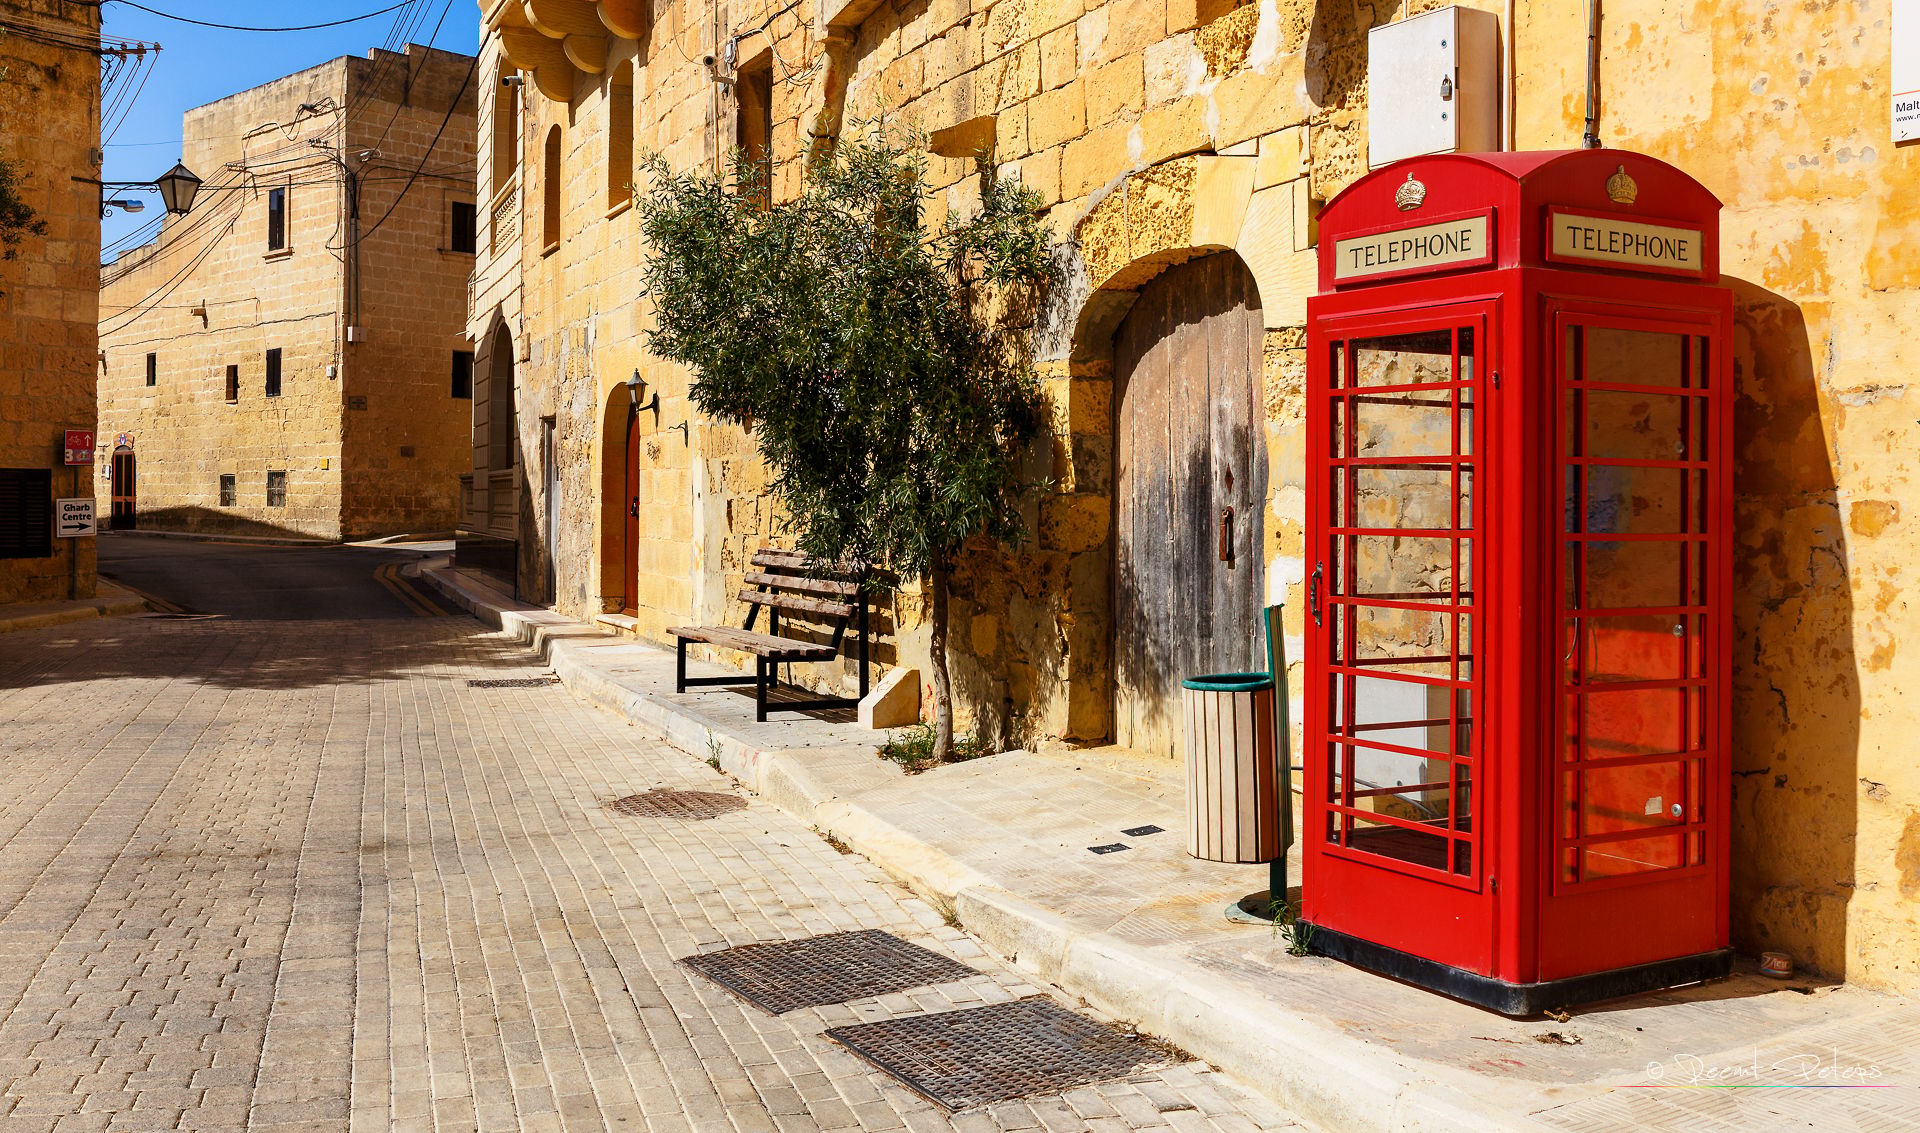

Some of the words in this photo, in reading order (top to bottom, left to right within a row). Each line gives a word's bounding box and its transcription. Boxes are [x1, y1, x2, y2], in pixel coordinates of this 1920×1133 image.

[1896, 100, 1920, 112] Malt
[1350, 229, 1472, 268] TELEPHONE
[1567, 225, 1689, 262] TELEPHONE
[65, 449, 73, 462] 3
[64, 504, 90, 512] Gharb
